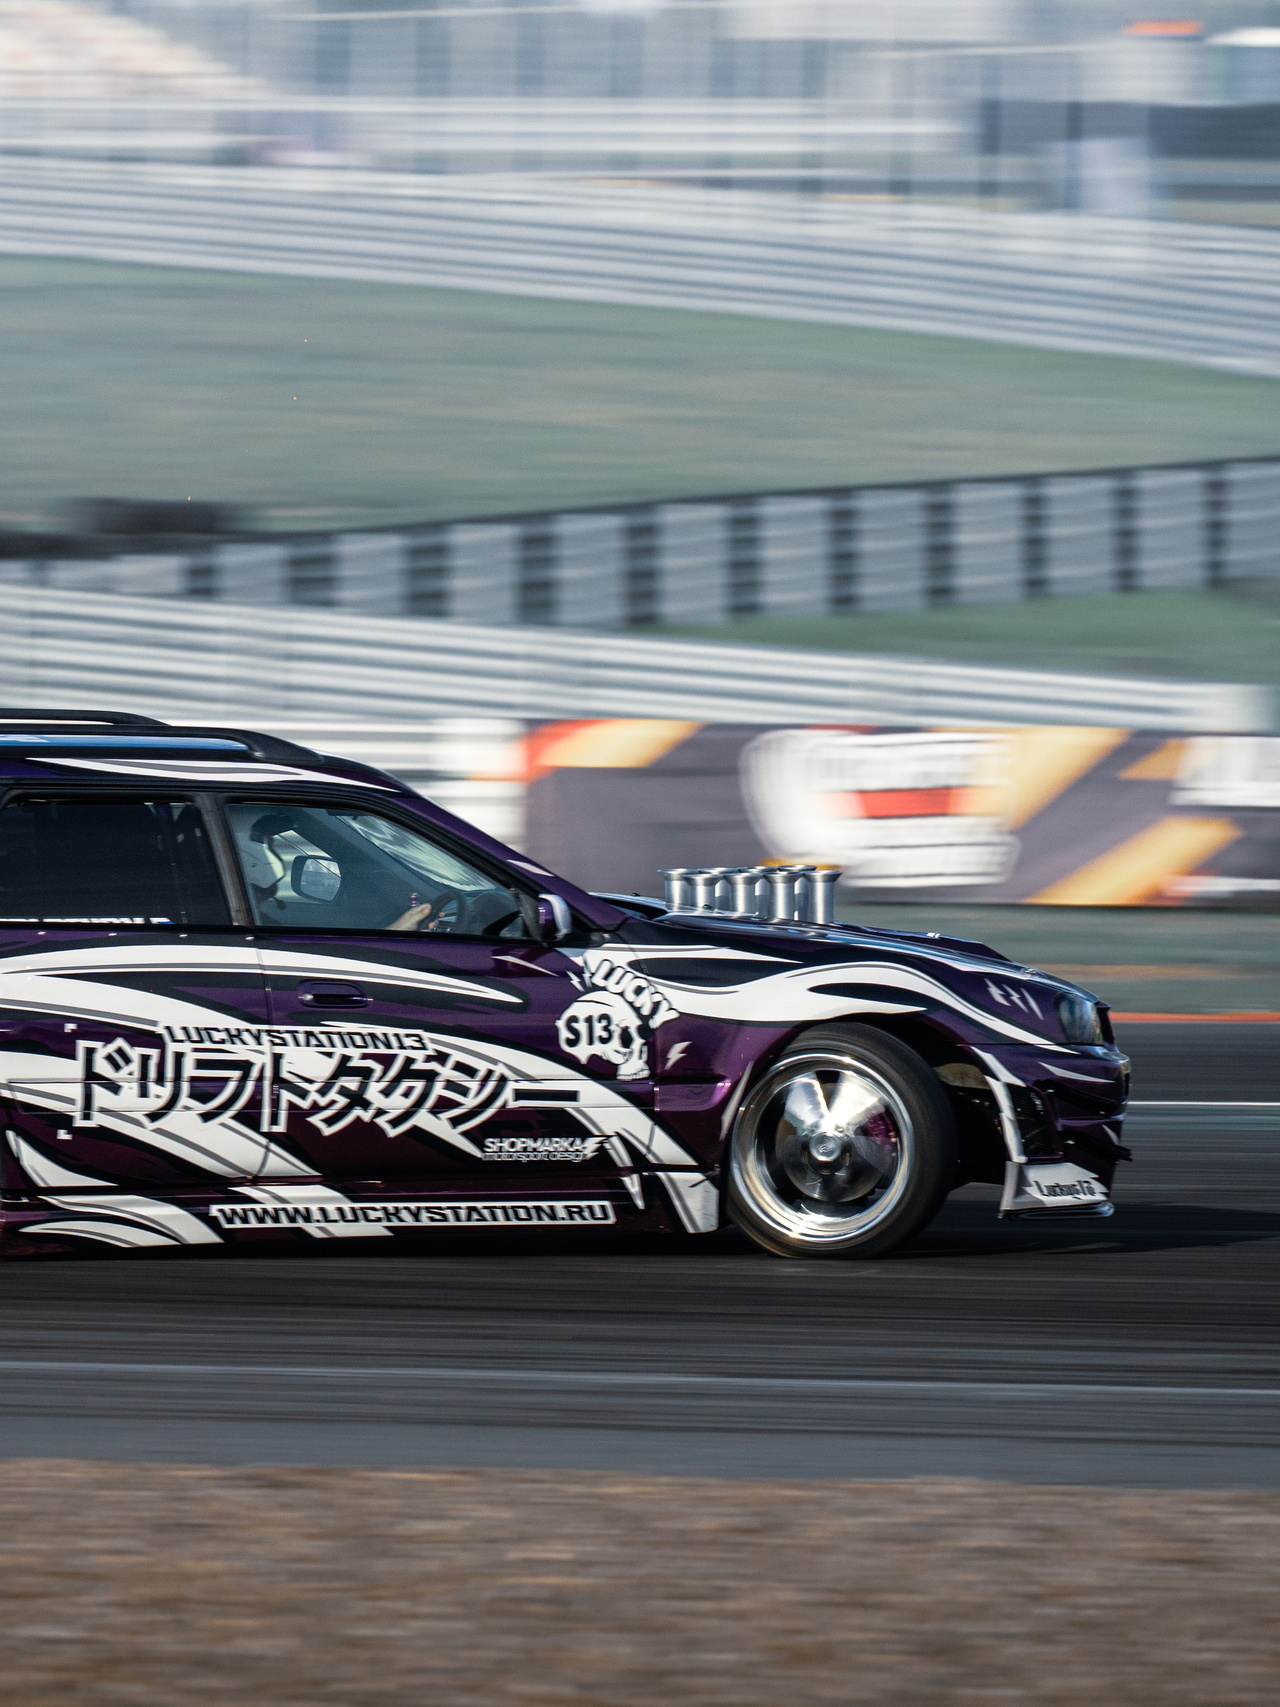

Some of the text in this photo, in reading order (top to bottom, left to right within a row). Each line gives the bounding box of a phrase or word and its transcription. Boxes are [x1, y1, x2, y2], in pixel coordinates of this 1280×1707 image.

[591, 959, 680, 1028] LUCKY
[164, 1026, 426, 1050] LUCKYSTATION13
[565, 1013, 613, 1048] S13
[78, 1041, 581, 1132] ドリフトタクシー
[483, 1137, 582, 1152] SHOPMARKA
[220, 1205, 610, 1224] WWW.LUCKYSTATION.RU
